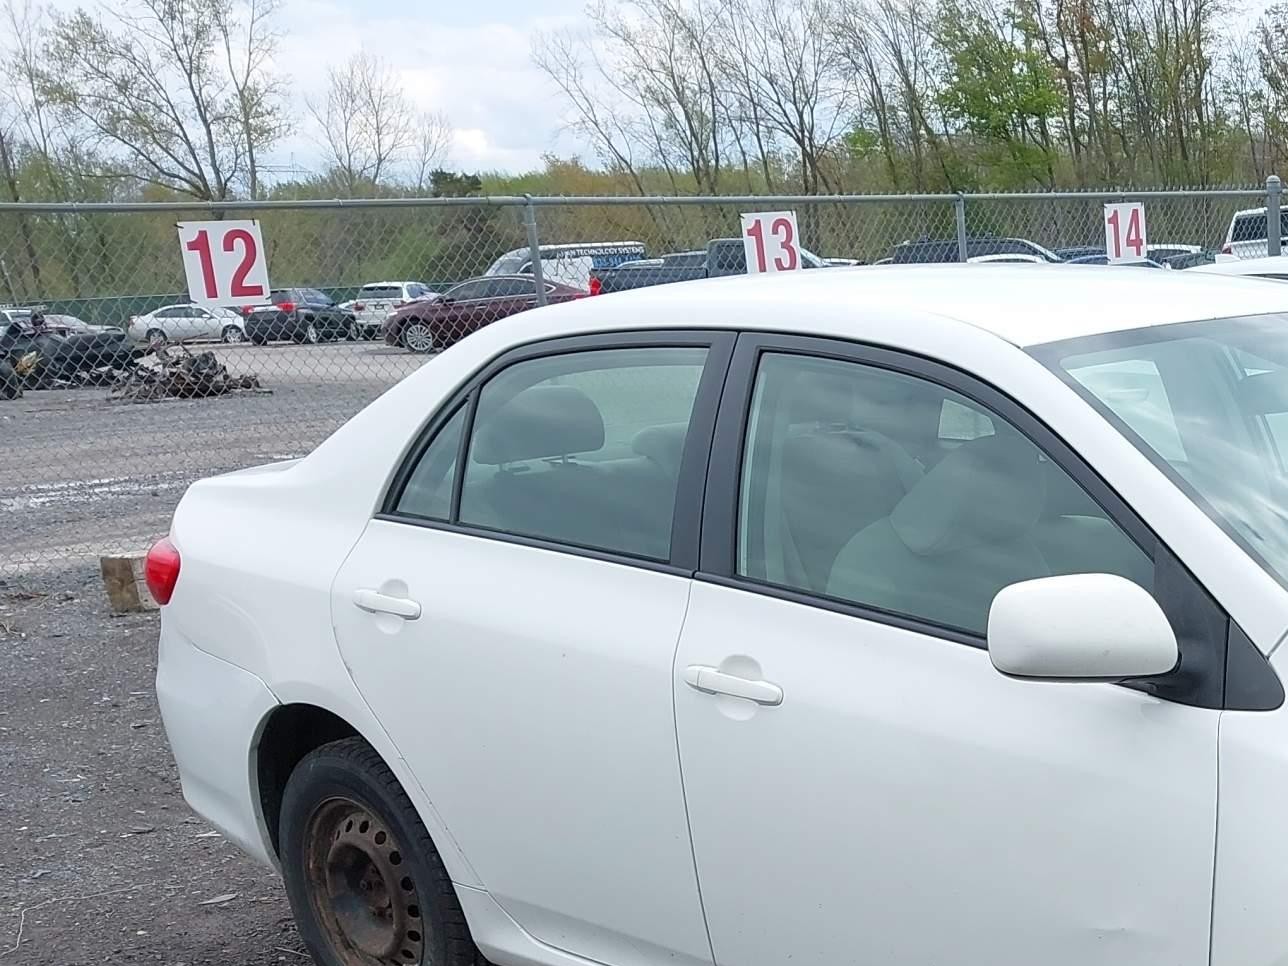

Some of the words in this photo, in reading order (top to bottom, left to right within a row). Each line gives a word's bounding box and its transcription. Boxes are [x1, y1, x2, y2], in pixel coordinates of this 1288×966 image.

[576, 247, 618, 256] TECHNOLOGY
[746, 217, 797, 273] 13
[1107, 208, 1144, 258] 14
[186, 228, 264, 299] 12
